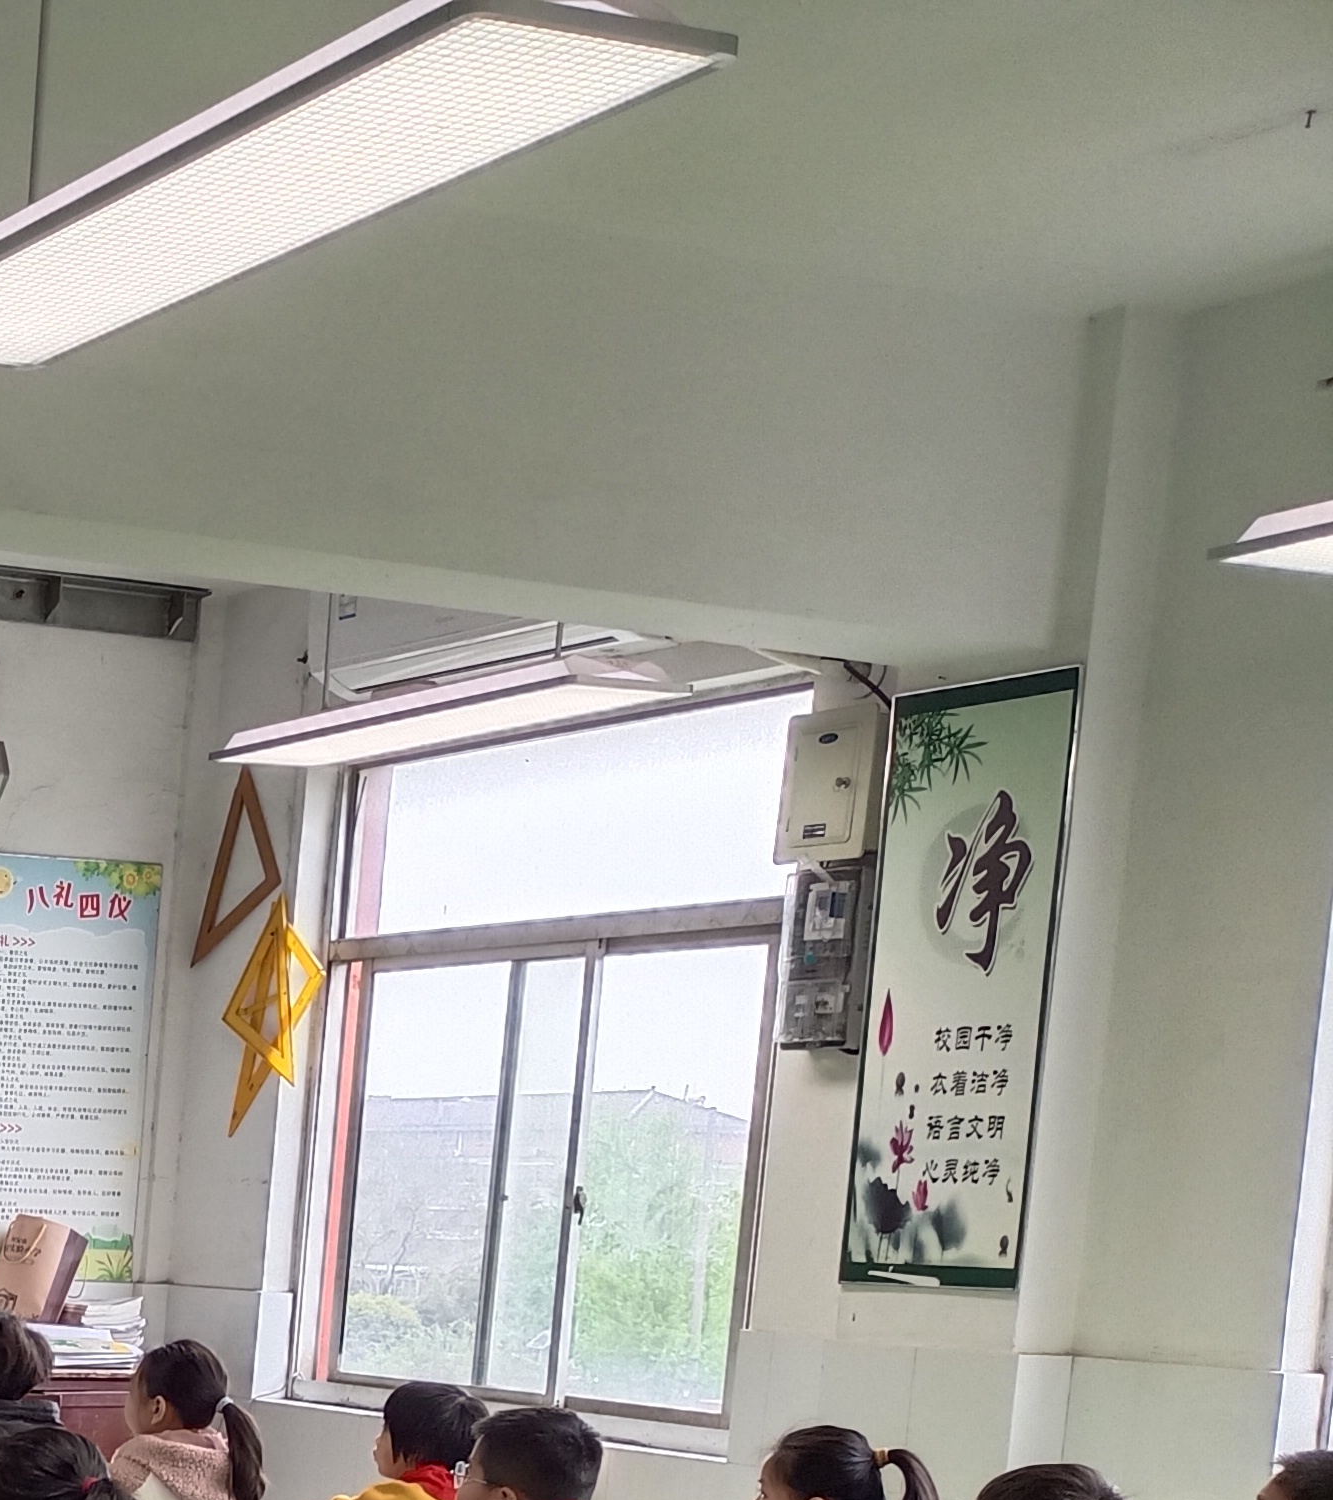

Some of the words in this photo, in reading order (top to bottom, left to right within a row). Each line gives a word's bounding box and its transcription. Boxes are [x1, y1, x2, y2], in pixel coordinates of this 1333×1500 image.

[936, 790, 1034, 976] 净
[27, 880, 132, 922] 八礼四仪
[934, 1023, 1013, 1053] 校园干净
[930, 1068, 1009, 1097] 衣着洁净
[926, 1115, 1006, 1141] 语言文明
[922, 1158, 1001, 1186] 心灵纯净
